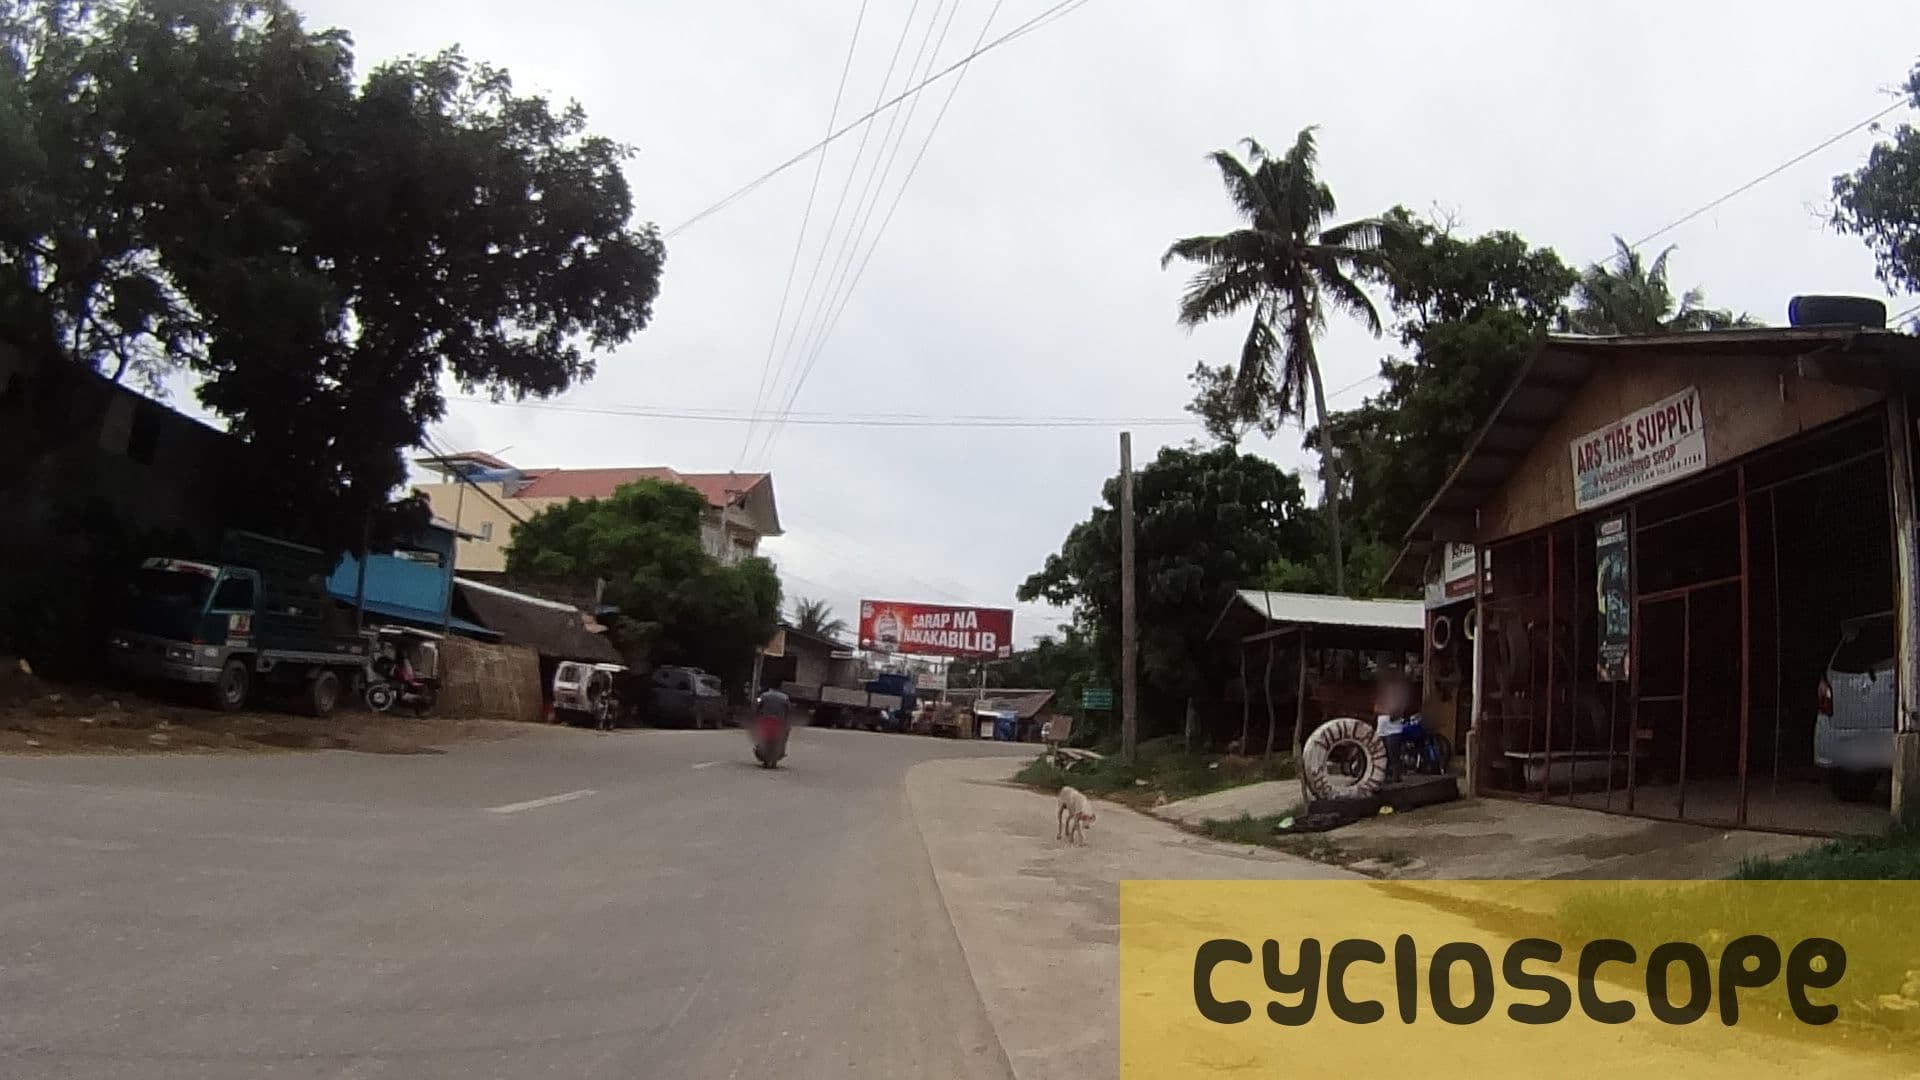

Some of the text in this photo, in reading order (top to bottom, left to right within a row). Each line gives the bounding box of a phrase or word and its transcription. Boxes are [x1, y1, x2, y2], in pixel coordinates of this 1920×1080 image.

[1577, 437, 1603, 476] ARS
[1604, 424, 1634, 464] TIRE
[1636, 395, 1694, 450] SUPPLY
[912, 610, 978, 629] SARAP NA
[903, 629, 997, 652] NAKAKABILIB
